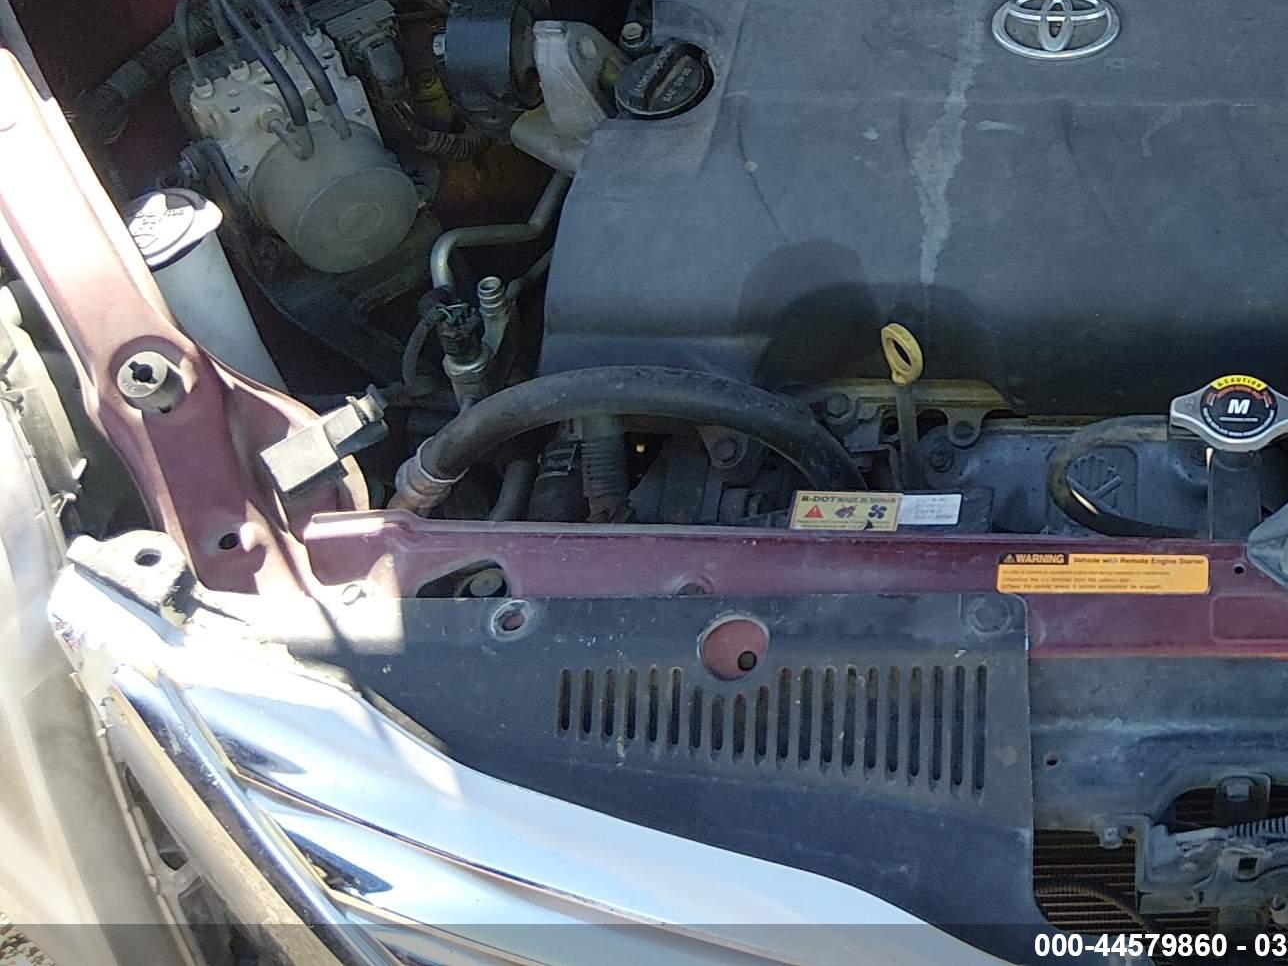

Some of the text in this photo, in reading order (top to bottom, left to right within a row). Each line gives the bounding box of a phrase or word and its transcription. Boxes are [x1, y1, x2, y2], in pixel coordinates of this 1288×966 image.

[1224, 376, 1263, 388] CAUTION
[1226, 398, 1251, 415] M
[1016, 553, 1065, 564] WARNING
[1120, 557, 1149, 565] Remote
[1151, 557, 1177, 566] Engine
